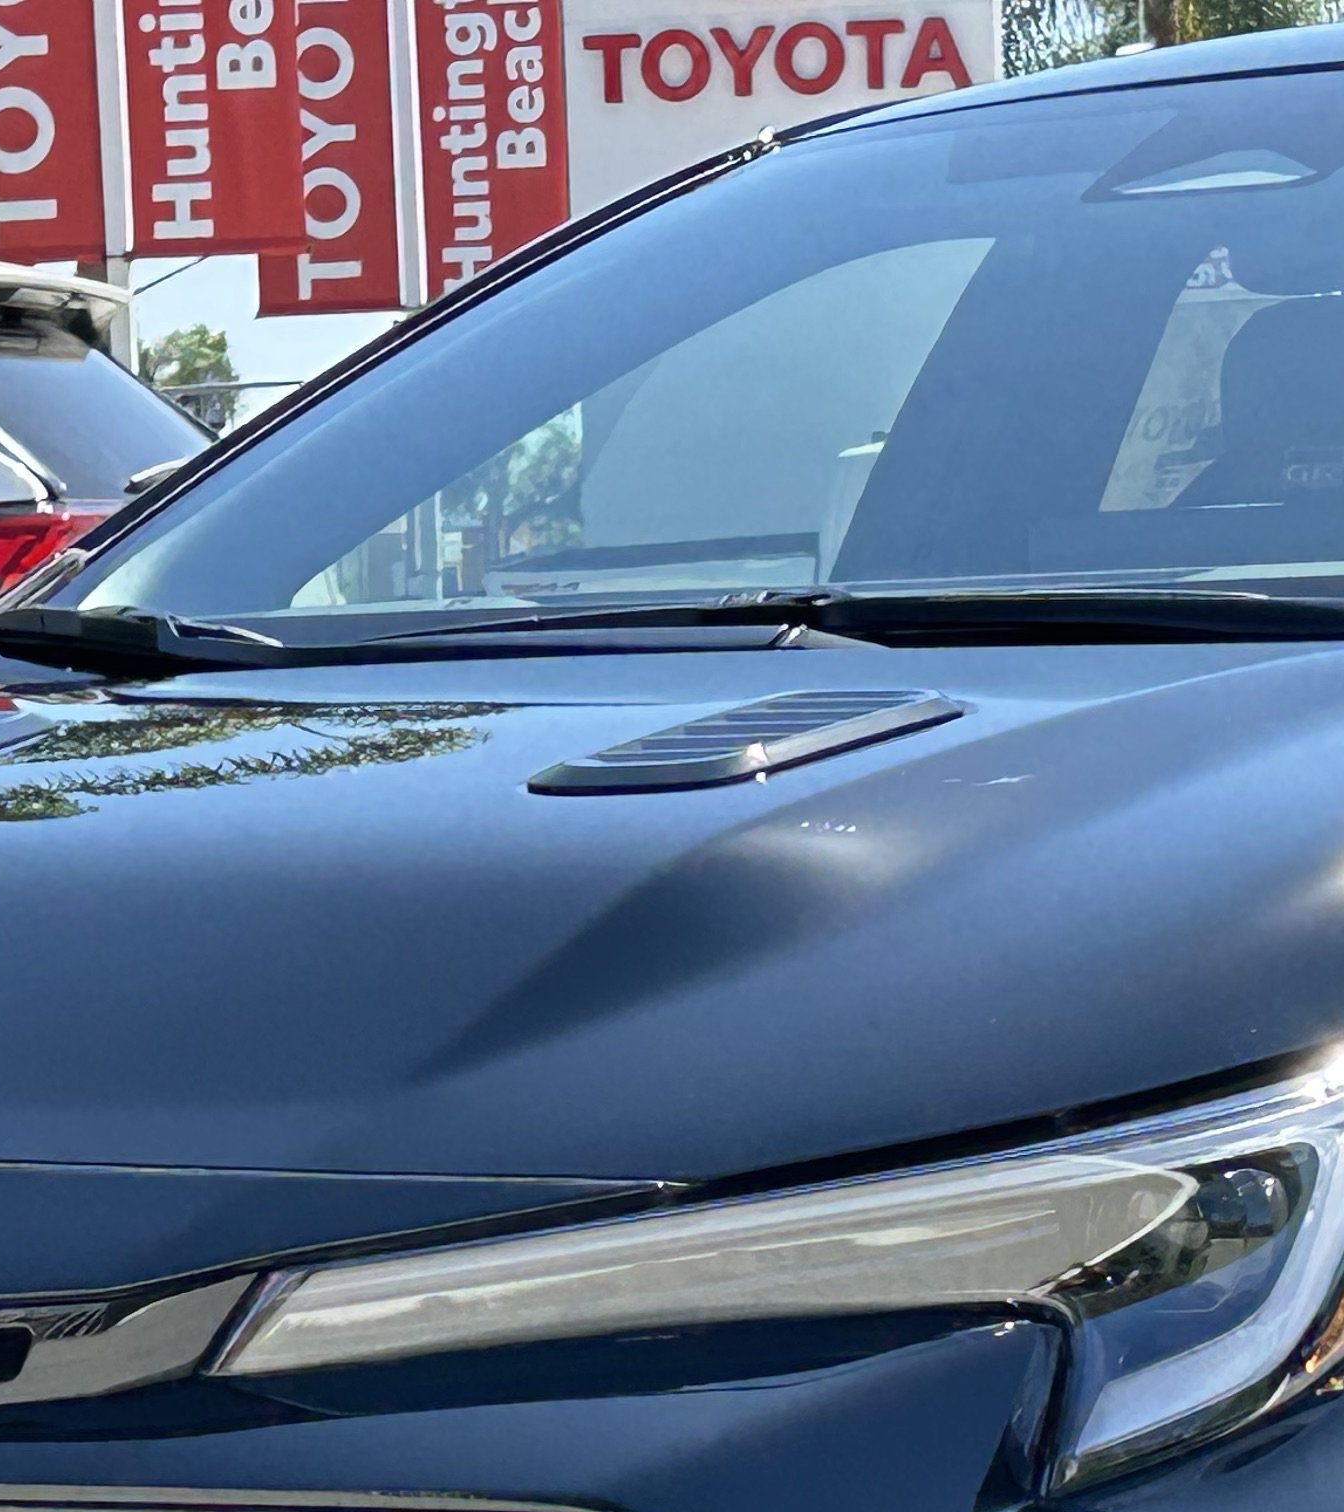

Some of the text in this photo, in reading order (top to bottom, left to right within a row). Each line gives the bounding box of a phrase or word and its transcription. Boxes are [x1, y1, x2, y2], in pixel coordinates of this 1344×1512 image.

[138, 0, 214, 240] Hunti
[294, 0, 362, 300] TOYO
[432, 0, 498, 297] Hunting
[486, 0, 547, 171] Beac
[583, 17, 973, 103] TOYOTA
